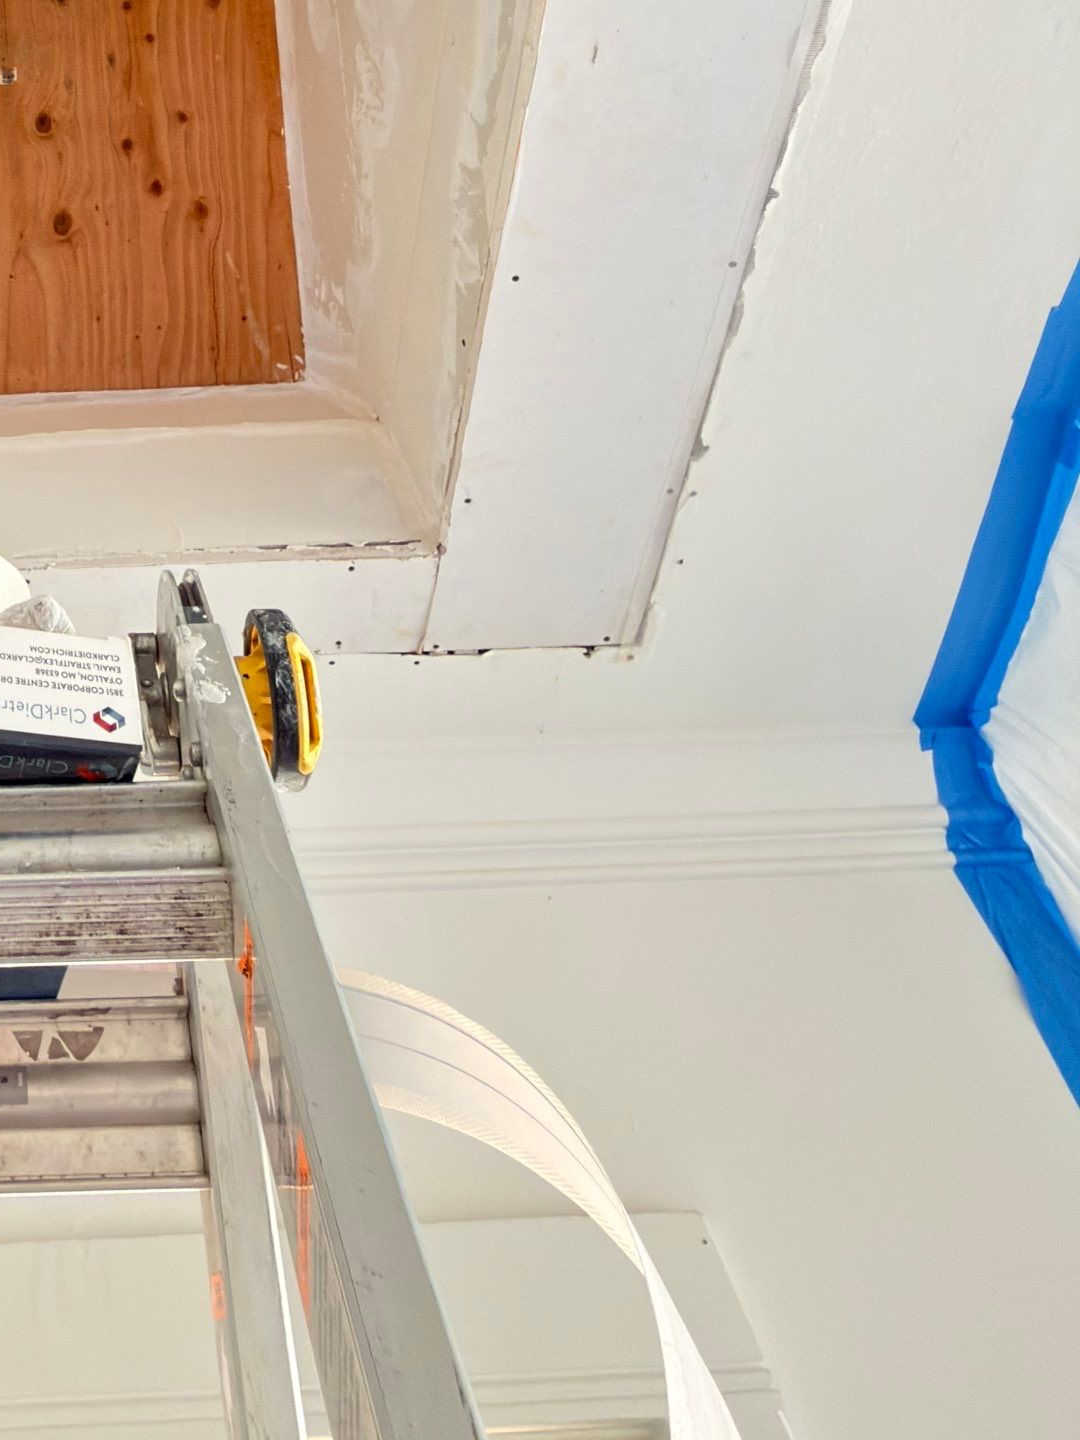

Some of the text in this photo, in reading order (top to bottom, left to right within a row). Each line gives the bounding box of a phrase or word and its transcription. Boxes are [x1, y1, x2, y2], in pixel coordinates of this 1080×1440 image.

[29, 644, 119, 662] CLARKDIETRICH.COM
[92, 662, 121, 673] EMAIL:
[14, 676, 49, 688] CENTRE
[34, 667, 122, 685] O'FALLON, MO 63368
[50, 680, 104, 695] CORPORATE
[105, 687, 123, 697] 3851
